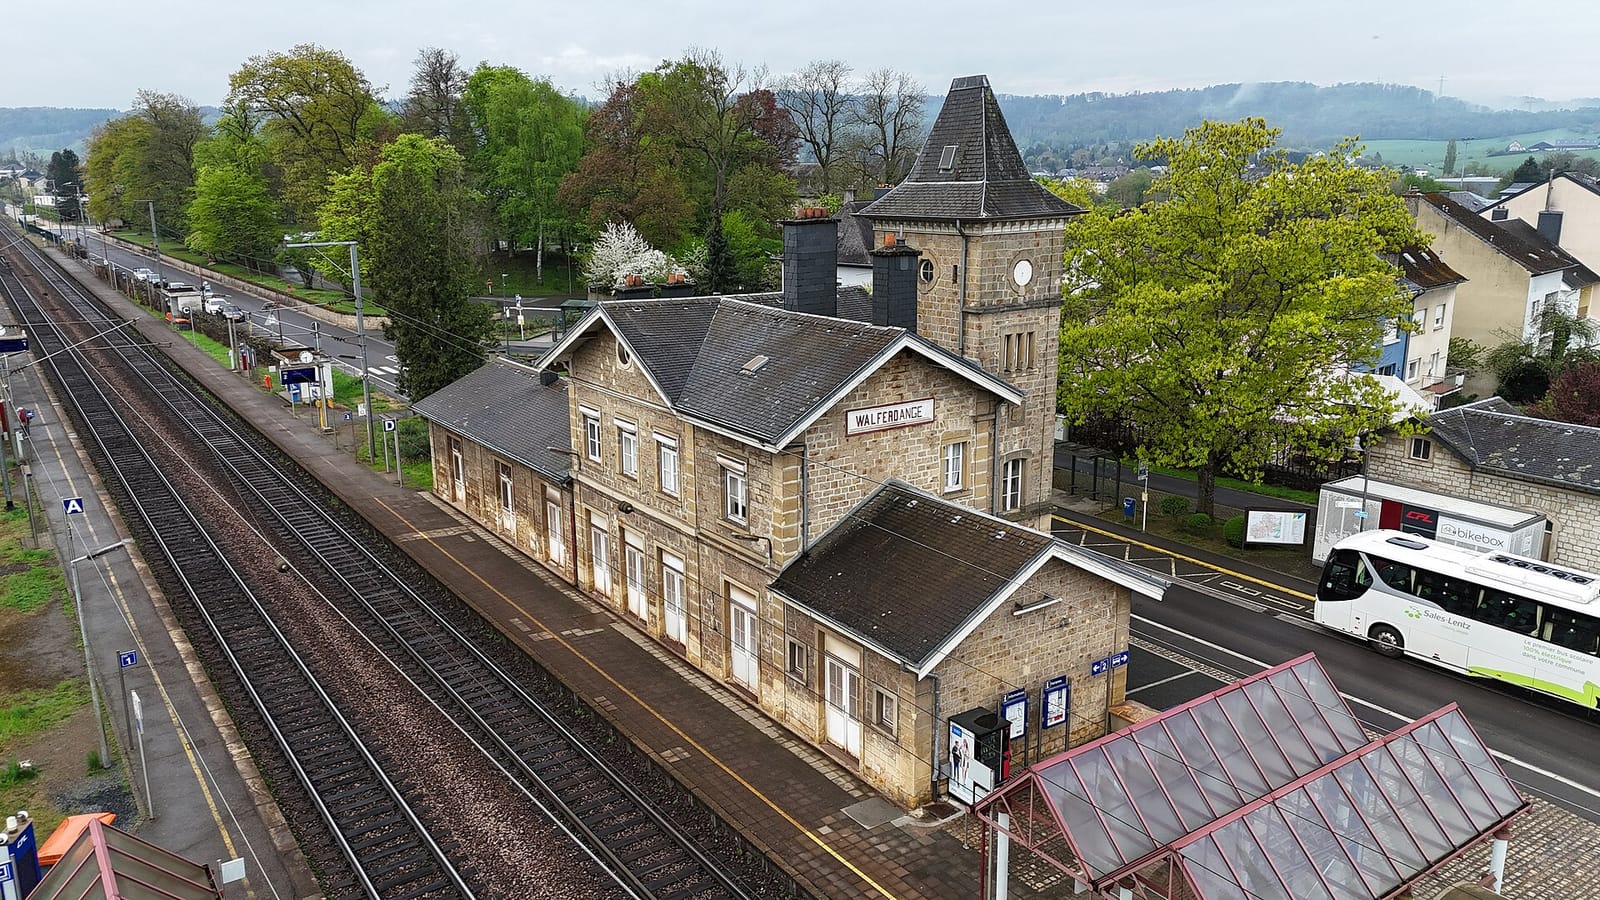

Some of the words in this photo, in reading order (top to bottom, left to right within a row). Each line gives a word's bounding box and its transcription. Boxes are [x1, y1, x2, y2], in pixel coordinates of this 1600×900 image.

[183, 306, 190, 314] C
[855, 406, 923, 427] WALFERDANGE
[385, 420, 395, 431] D
[67, 499, 83, 514] A
[1406, 510, 1433, 523] CFL
[1457, 528, 1505, 548] bikebox
[1423, 609, 1472, 631] Sales-Lentz
[1557, 649, 1568, 657] bus
[1102, 662, 1107, 671] 2
